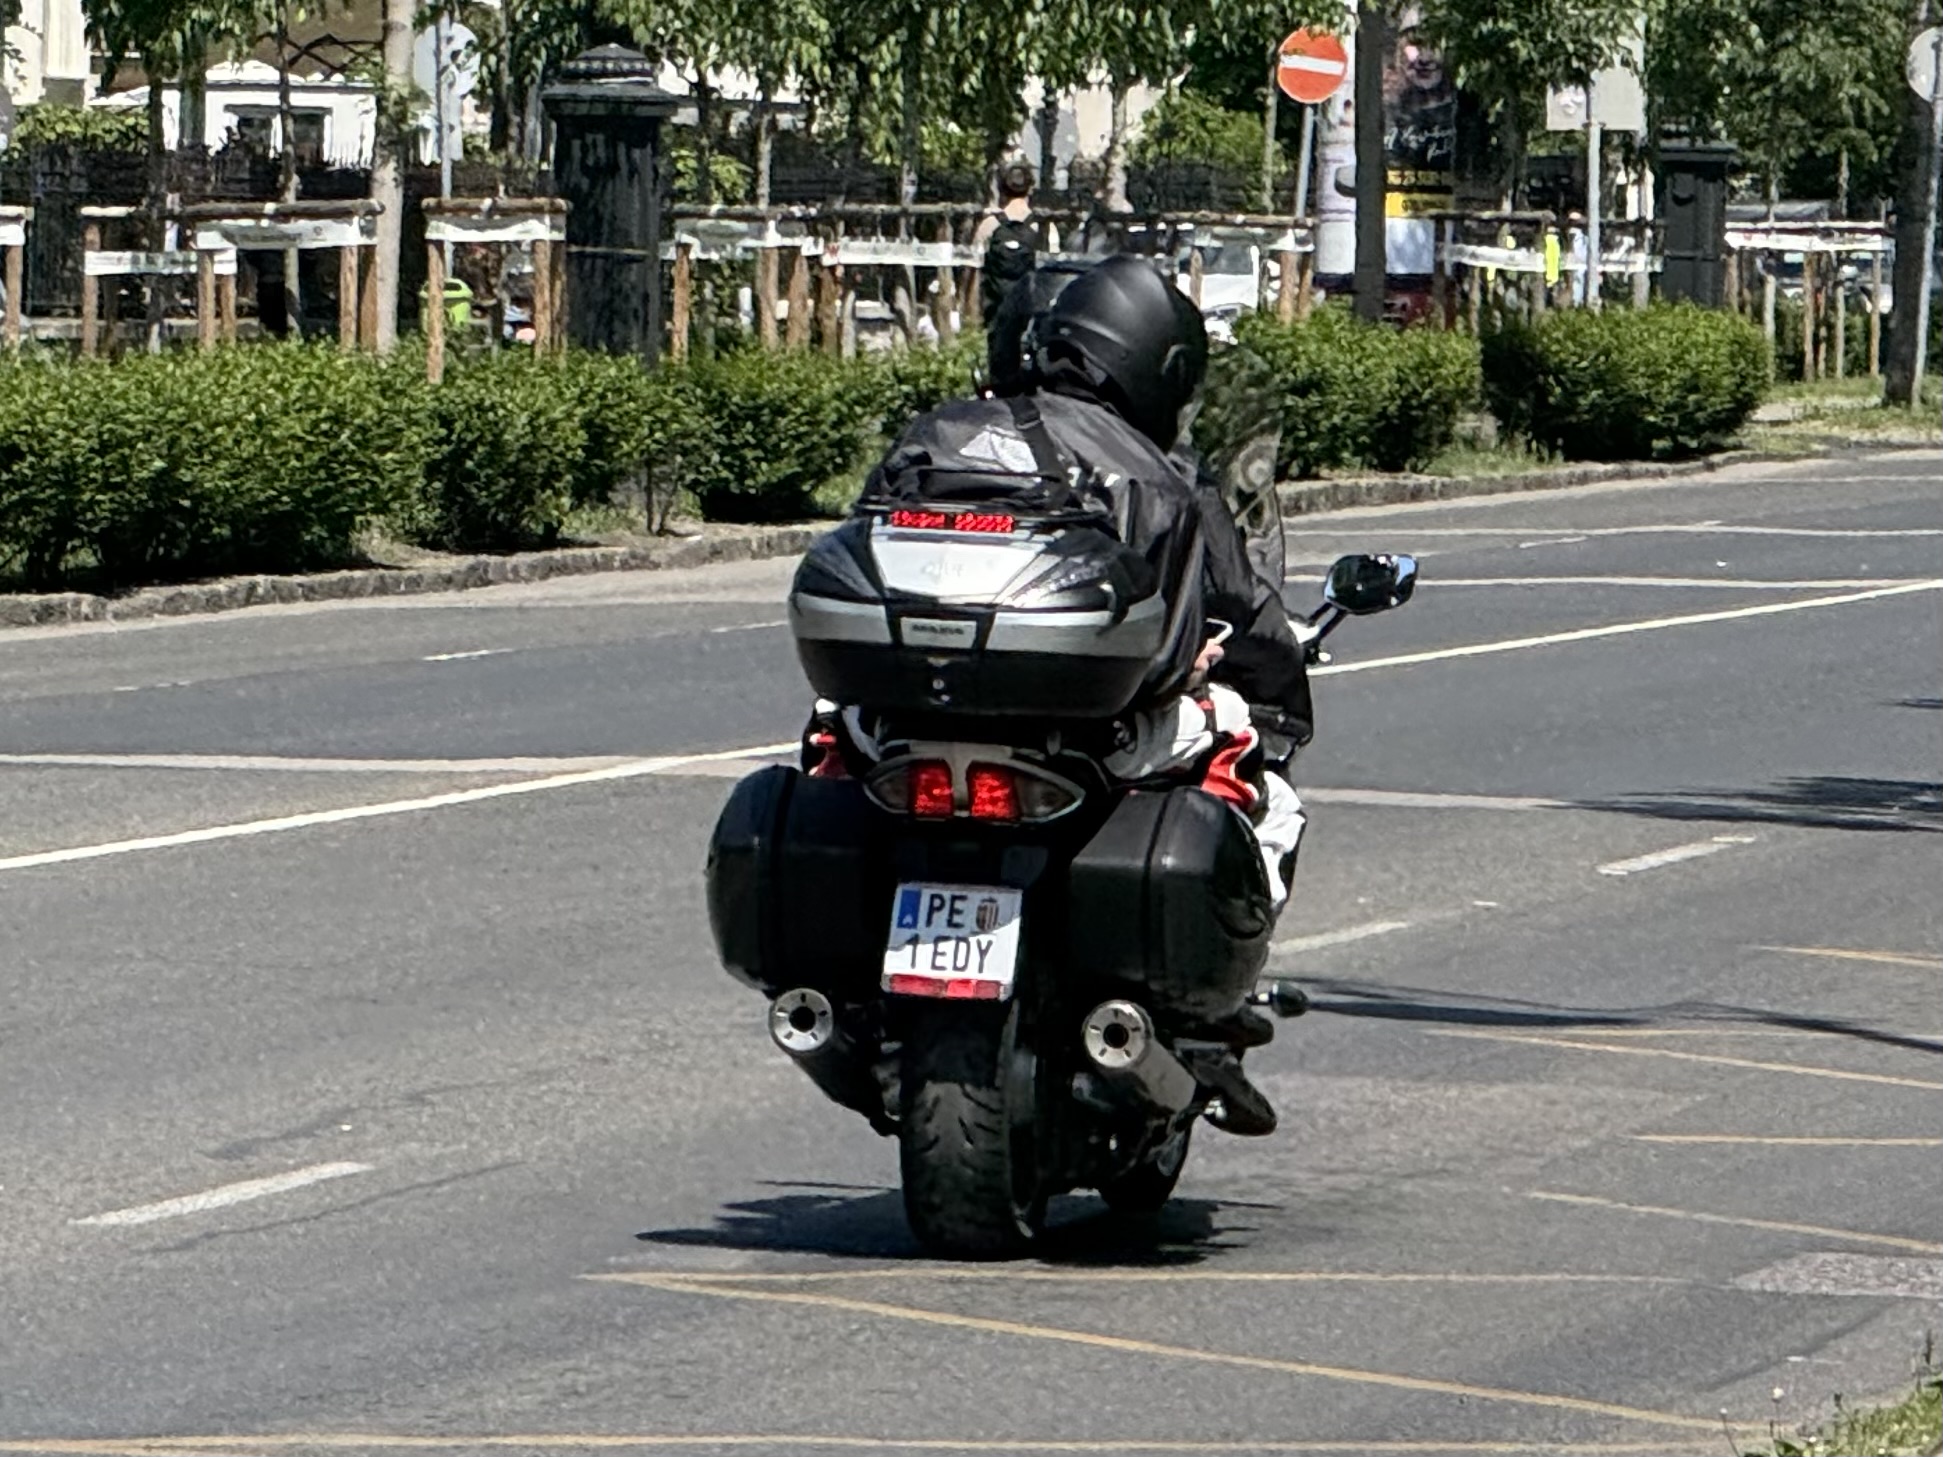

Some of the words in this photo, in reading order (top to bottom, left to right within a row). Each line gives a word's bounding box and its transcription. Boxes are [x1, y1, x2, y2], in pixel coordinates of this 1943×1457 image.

[925, 893, 968, 928] PE
[905, 933, 920, 969] 1
[931, 935, 993, 974] EDY
